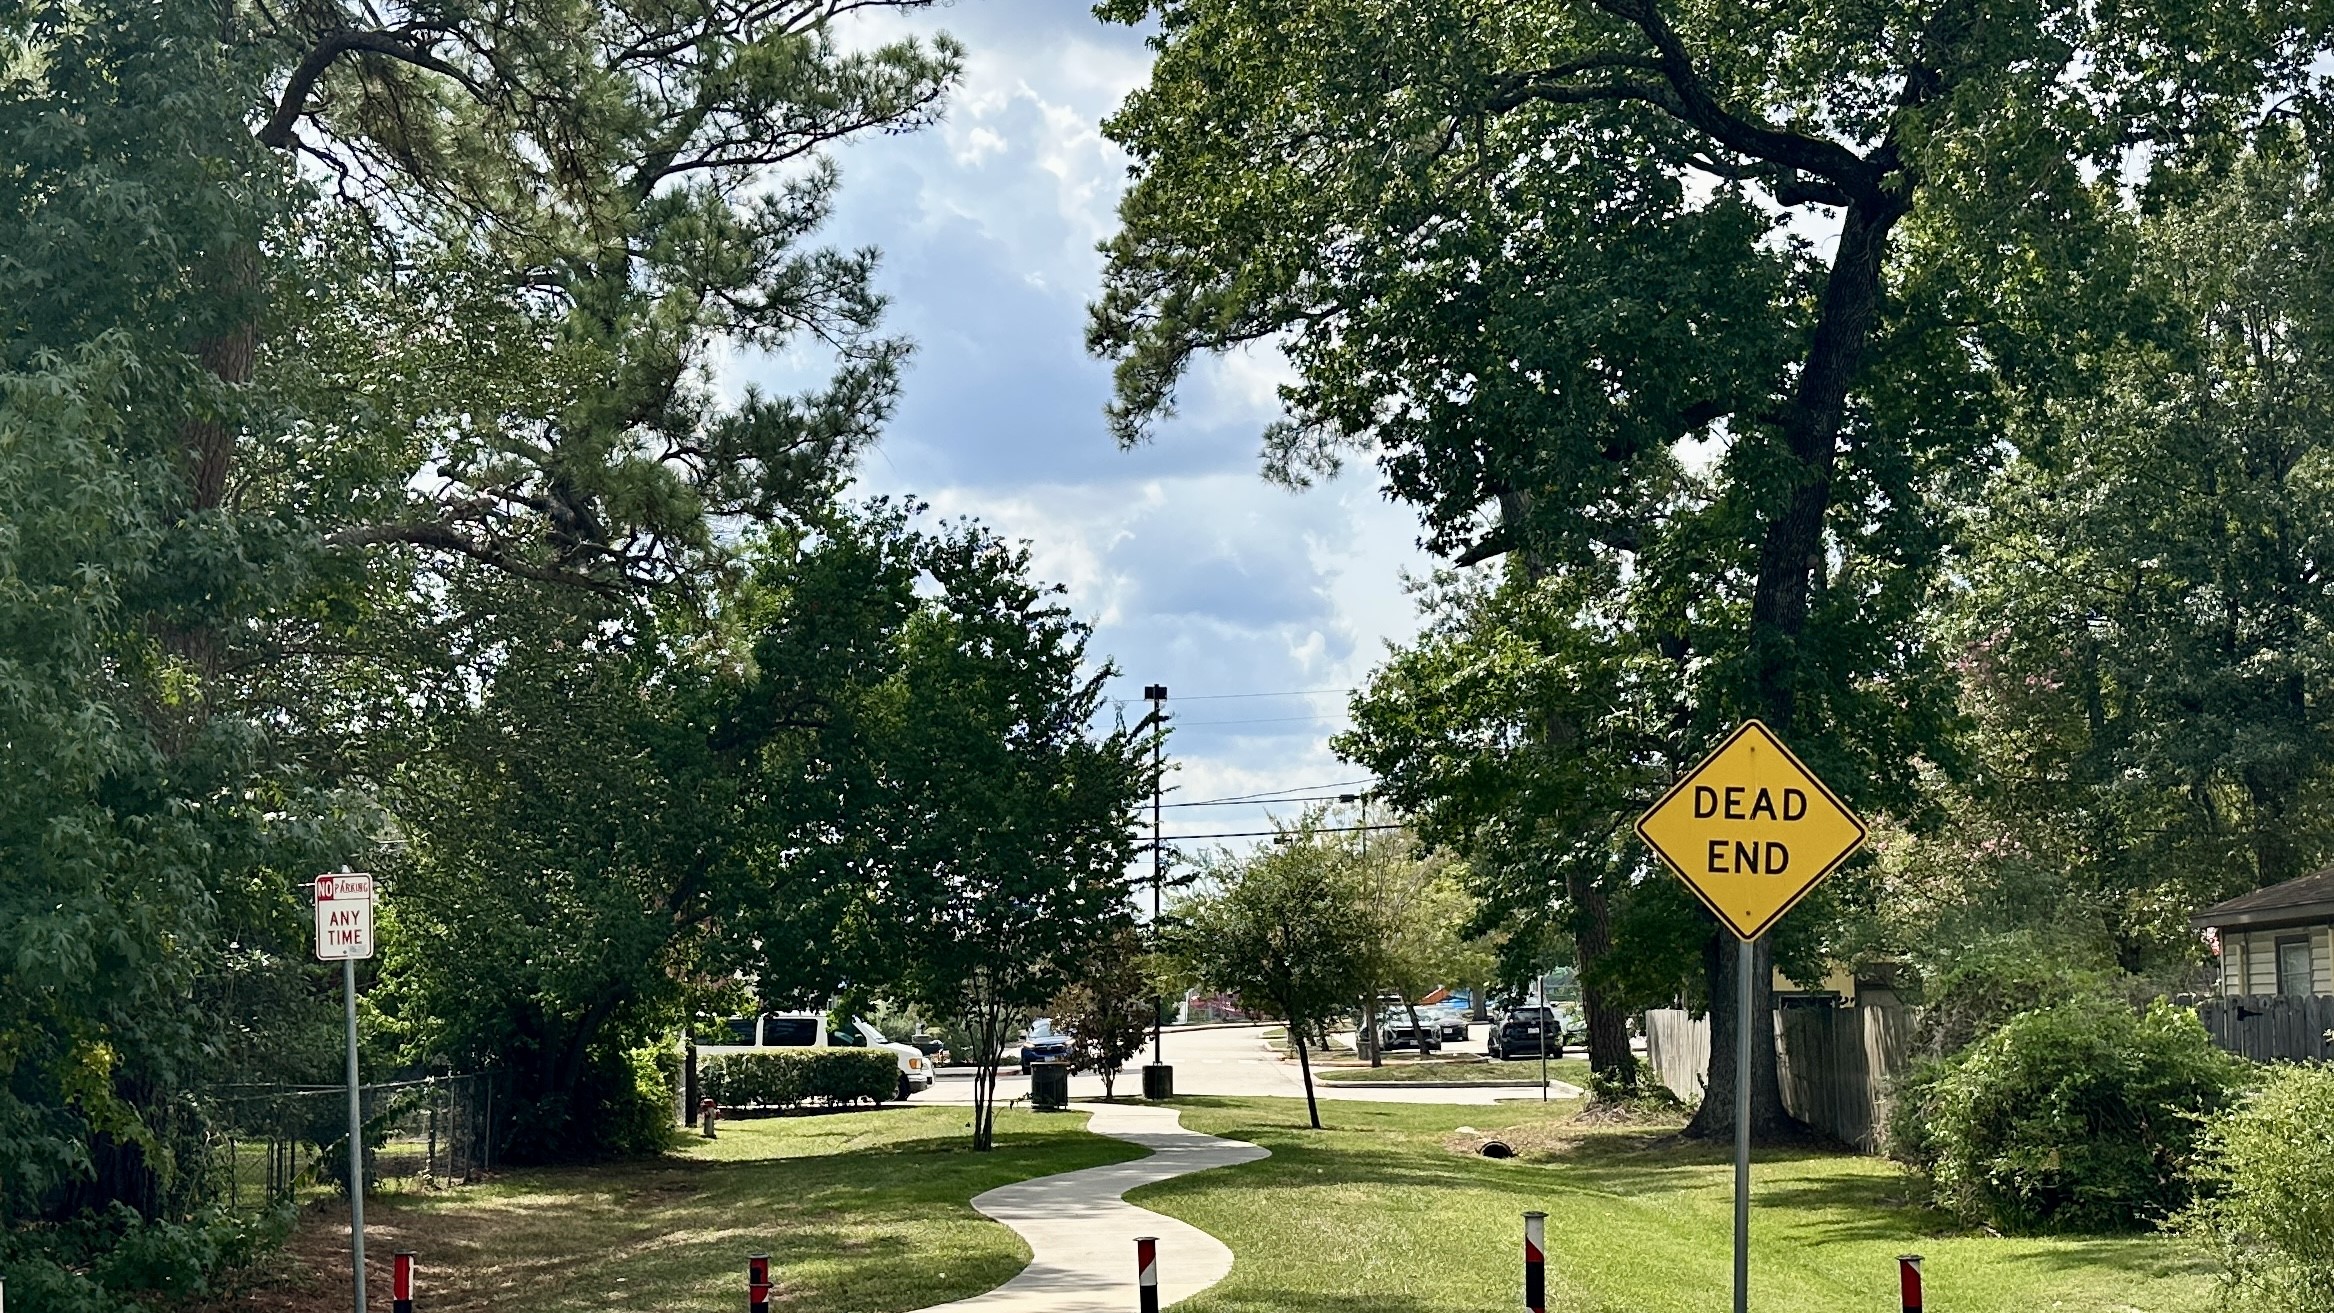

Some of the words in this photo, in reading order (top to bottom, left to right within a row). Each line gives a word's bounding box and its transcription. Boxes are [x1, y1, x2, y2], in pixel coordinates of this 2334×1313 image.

[1694, 785, 1807, 821] DEAD
[1708, 840, 1789, 875] END
[317, 881, 333, 897] NO
[335, 880, 368, 893] PARKING
[329, 911, 360, 926] ANY
[328, 929, 362, 945] TIME
